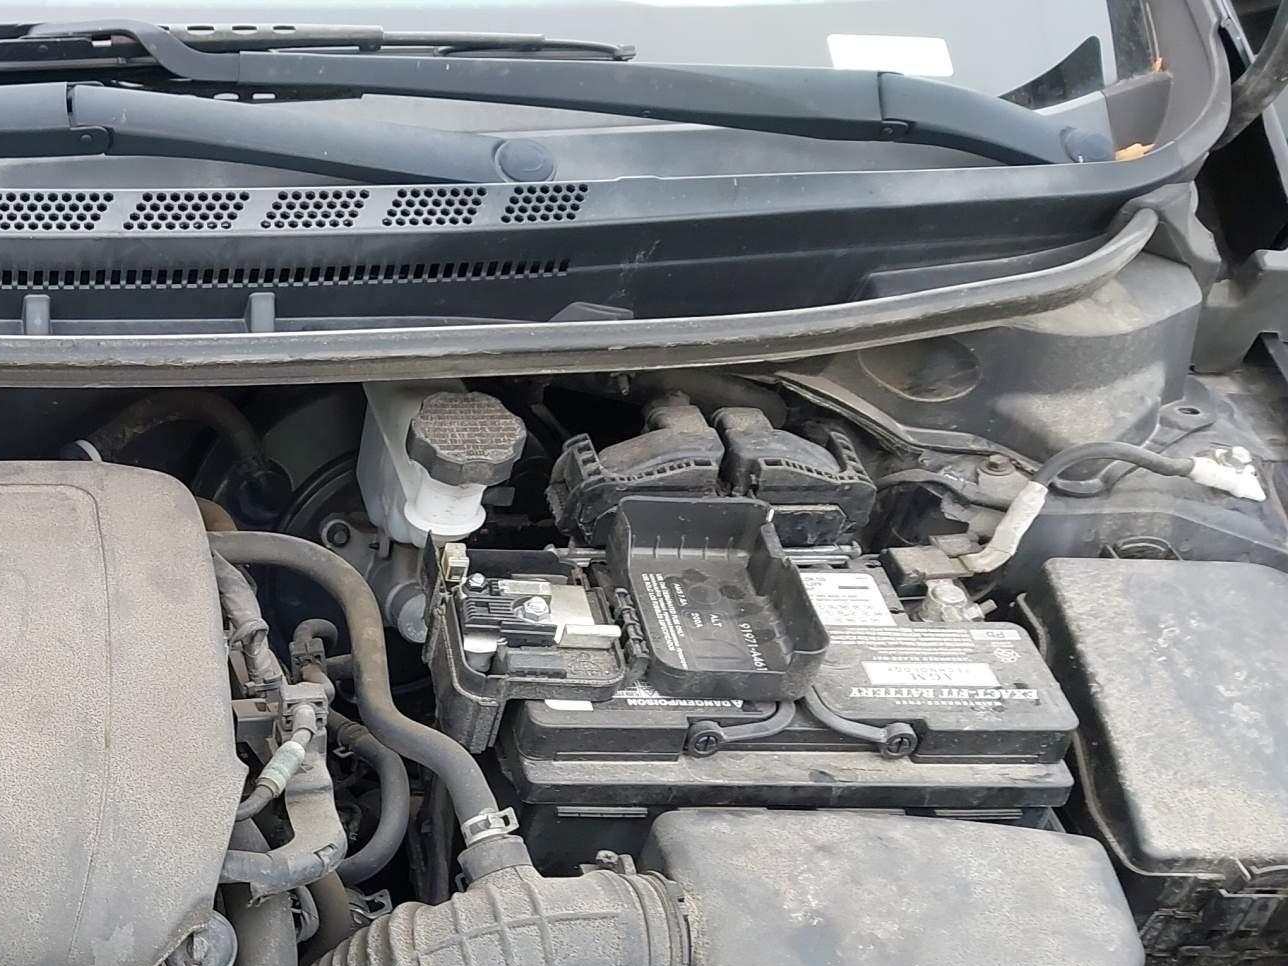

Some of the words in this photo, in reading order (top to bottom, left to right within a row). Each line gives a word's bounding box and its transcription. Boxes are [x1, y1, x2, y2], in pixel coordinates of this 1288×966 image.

[710, 614, 724, 628] ALT
[911, 672, 954, 681] AGM
[850, 687, 937, 698] BATTERY
[940, 688, 1038, 699] EXACT-FIT
